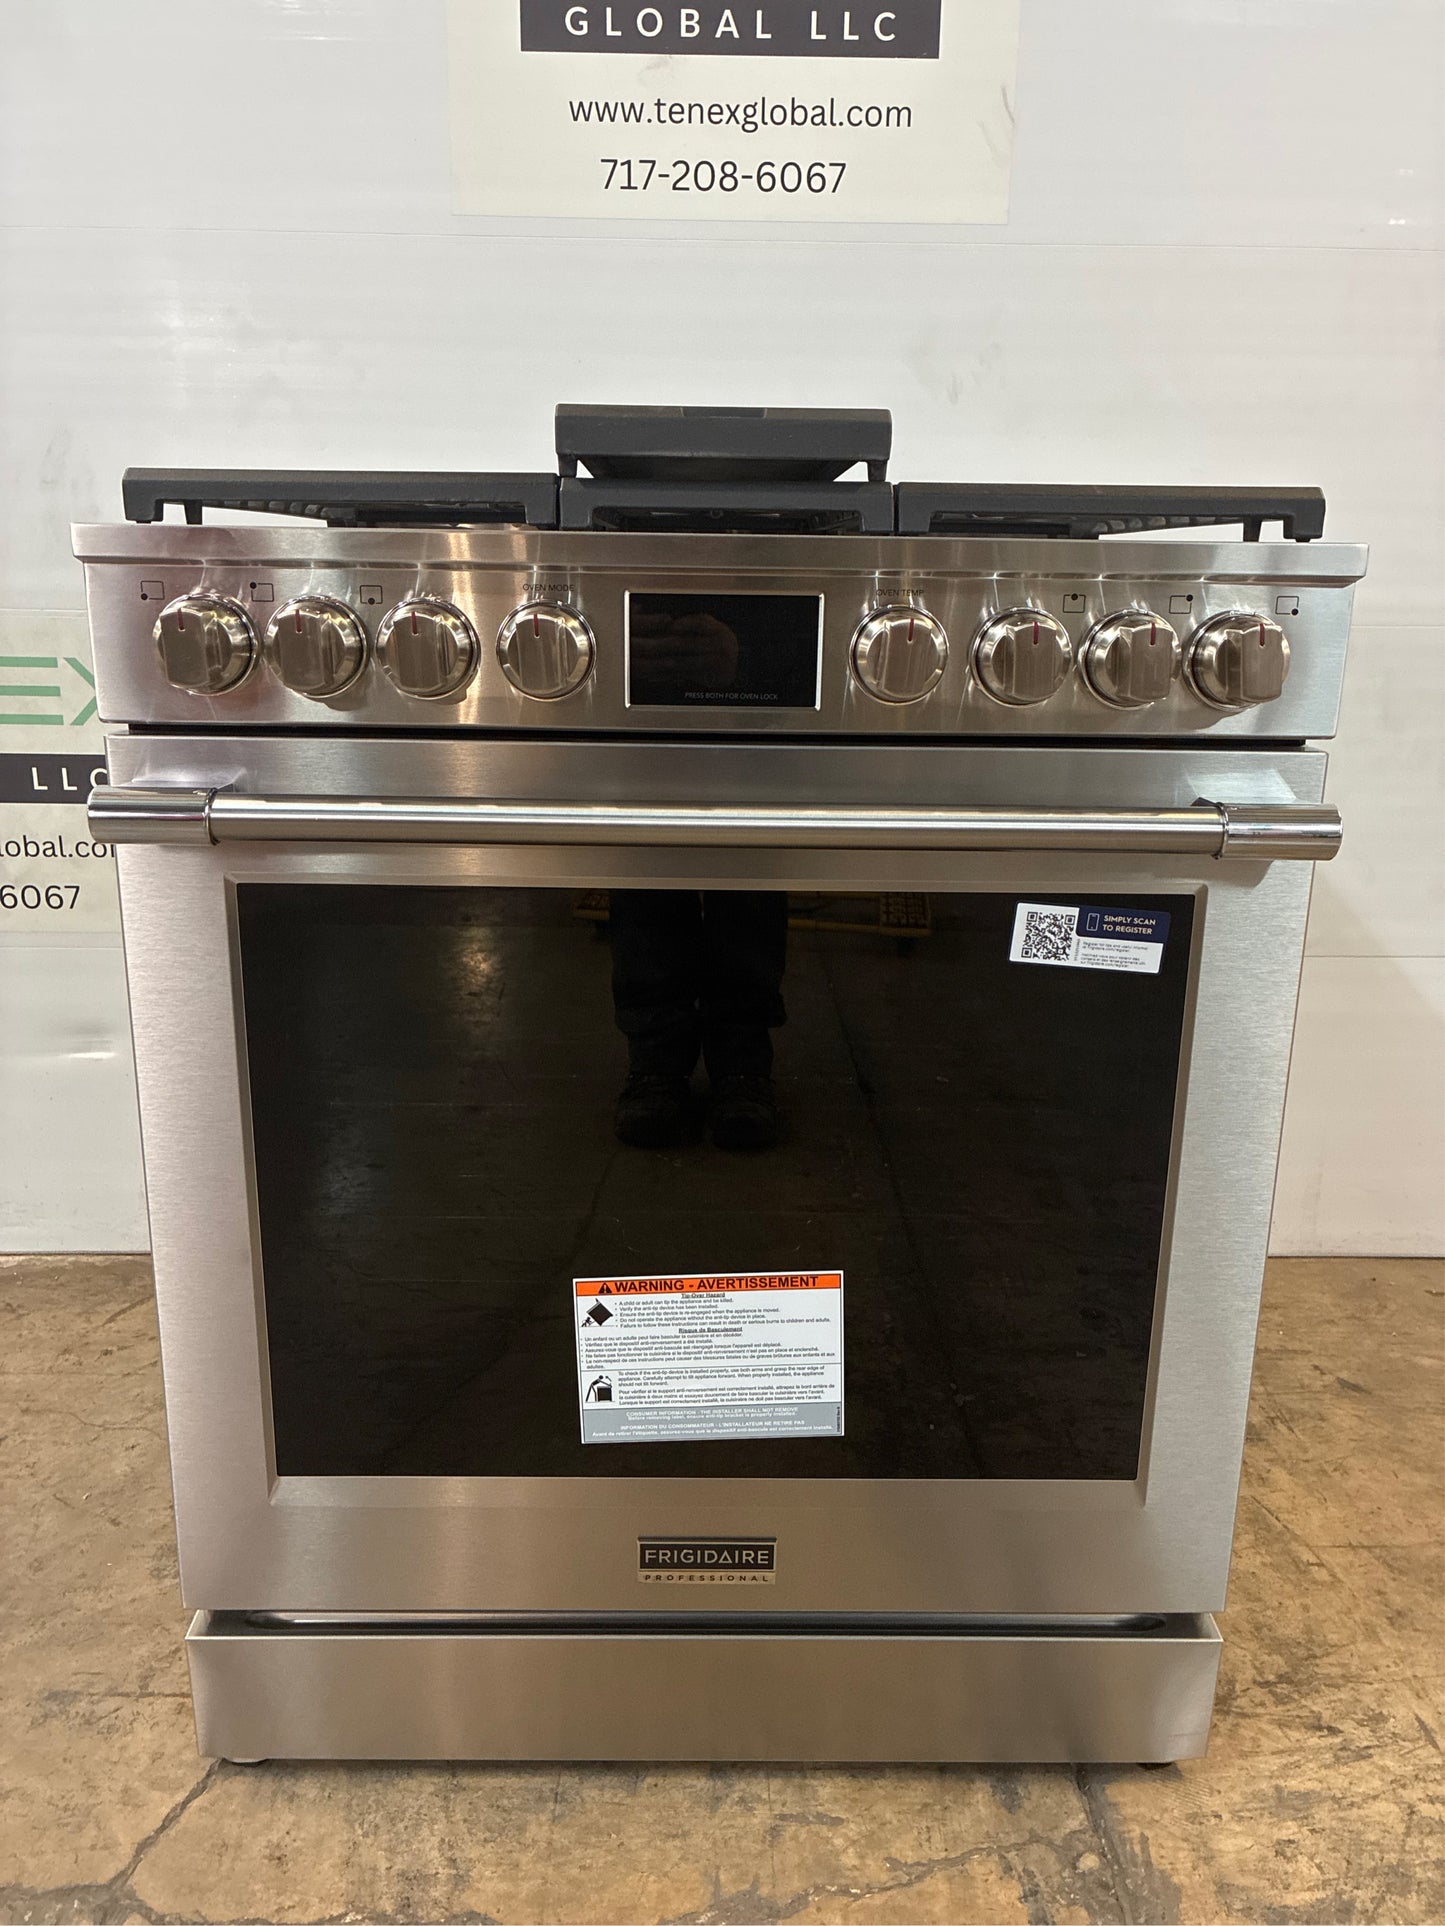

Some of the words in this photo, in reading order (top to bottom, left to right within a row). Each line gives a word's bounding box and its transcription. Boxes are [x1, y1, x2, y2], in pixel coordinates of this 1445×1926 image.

[564, 7, 772, 39] GLOBAL
[810, 10, 897, 42] LLC
[568, 97, 913, 133] www.tenexglobal.com
[600, 158, 847, 193] 717-208-6067
[522, 583, 546, 591] OVEN
[548, 584, 576, 592] MODE
[1104, 915, 1132, 924] SIMPLY
[1133, 917, 1156, 925] SCAN
[1115, 925, 1153, 935] REGISTER
[615, 1279, 685, 1292] WARNING
[696, 1276, 819, 1290] AVERTISSEMENT
[644, 1550, 769, 1564] FRIGIDAIRE
[644, 1574, 769, 1582] PROFESSIONAL
